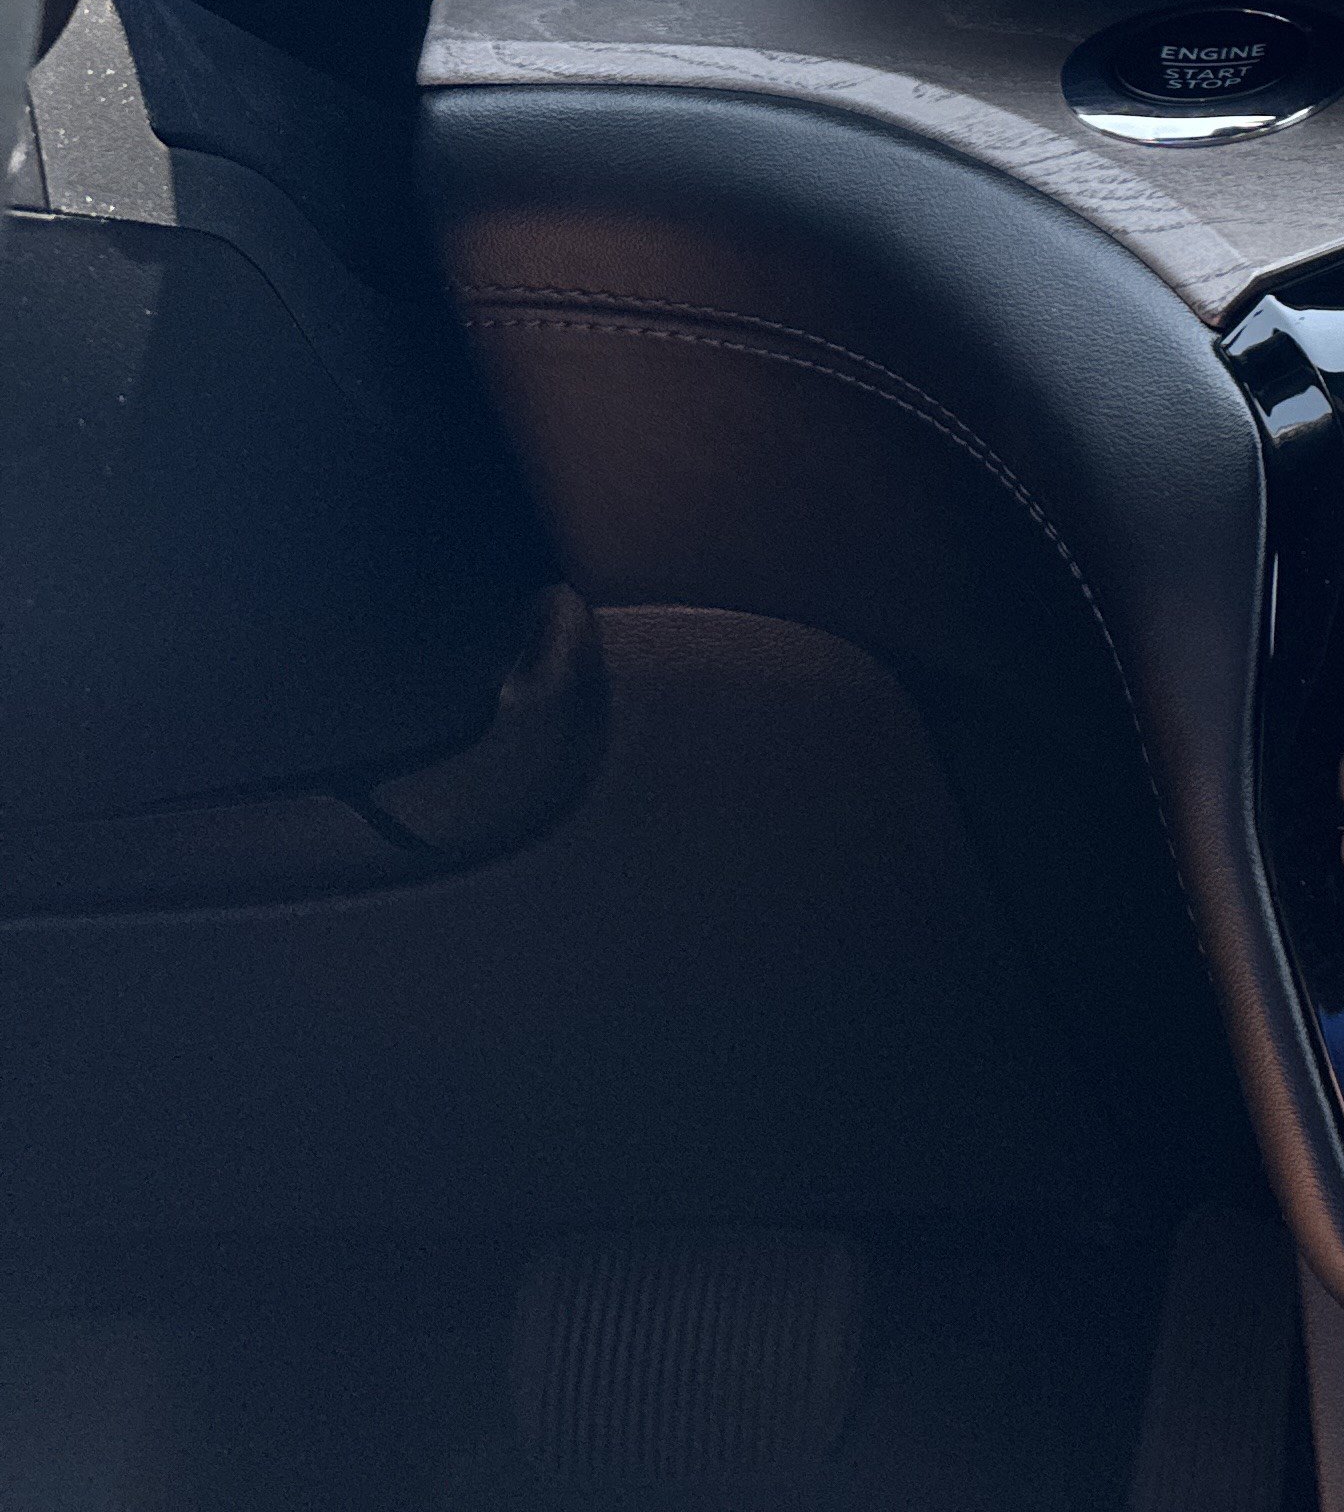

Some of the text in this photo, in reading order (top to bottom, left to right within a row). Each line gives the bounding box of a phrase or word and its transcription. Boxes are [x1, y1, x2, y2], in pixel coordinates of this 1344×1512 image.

[1160, 43, 1267, 61] ENGINE
[1163, 65, 1253, 80] START
[1166, 78, 1242, 89] STOP
